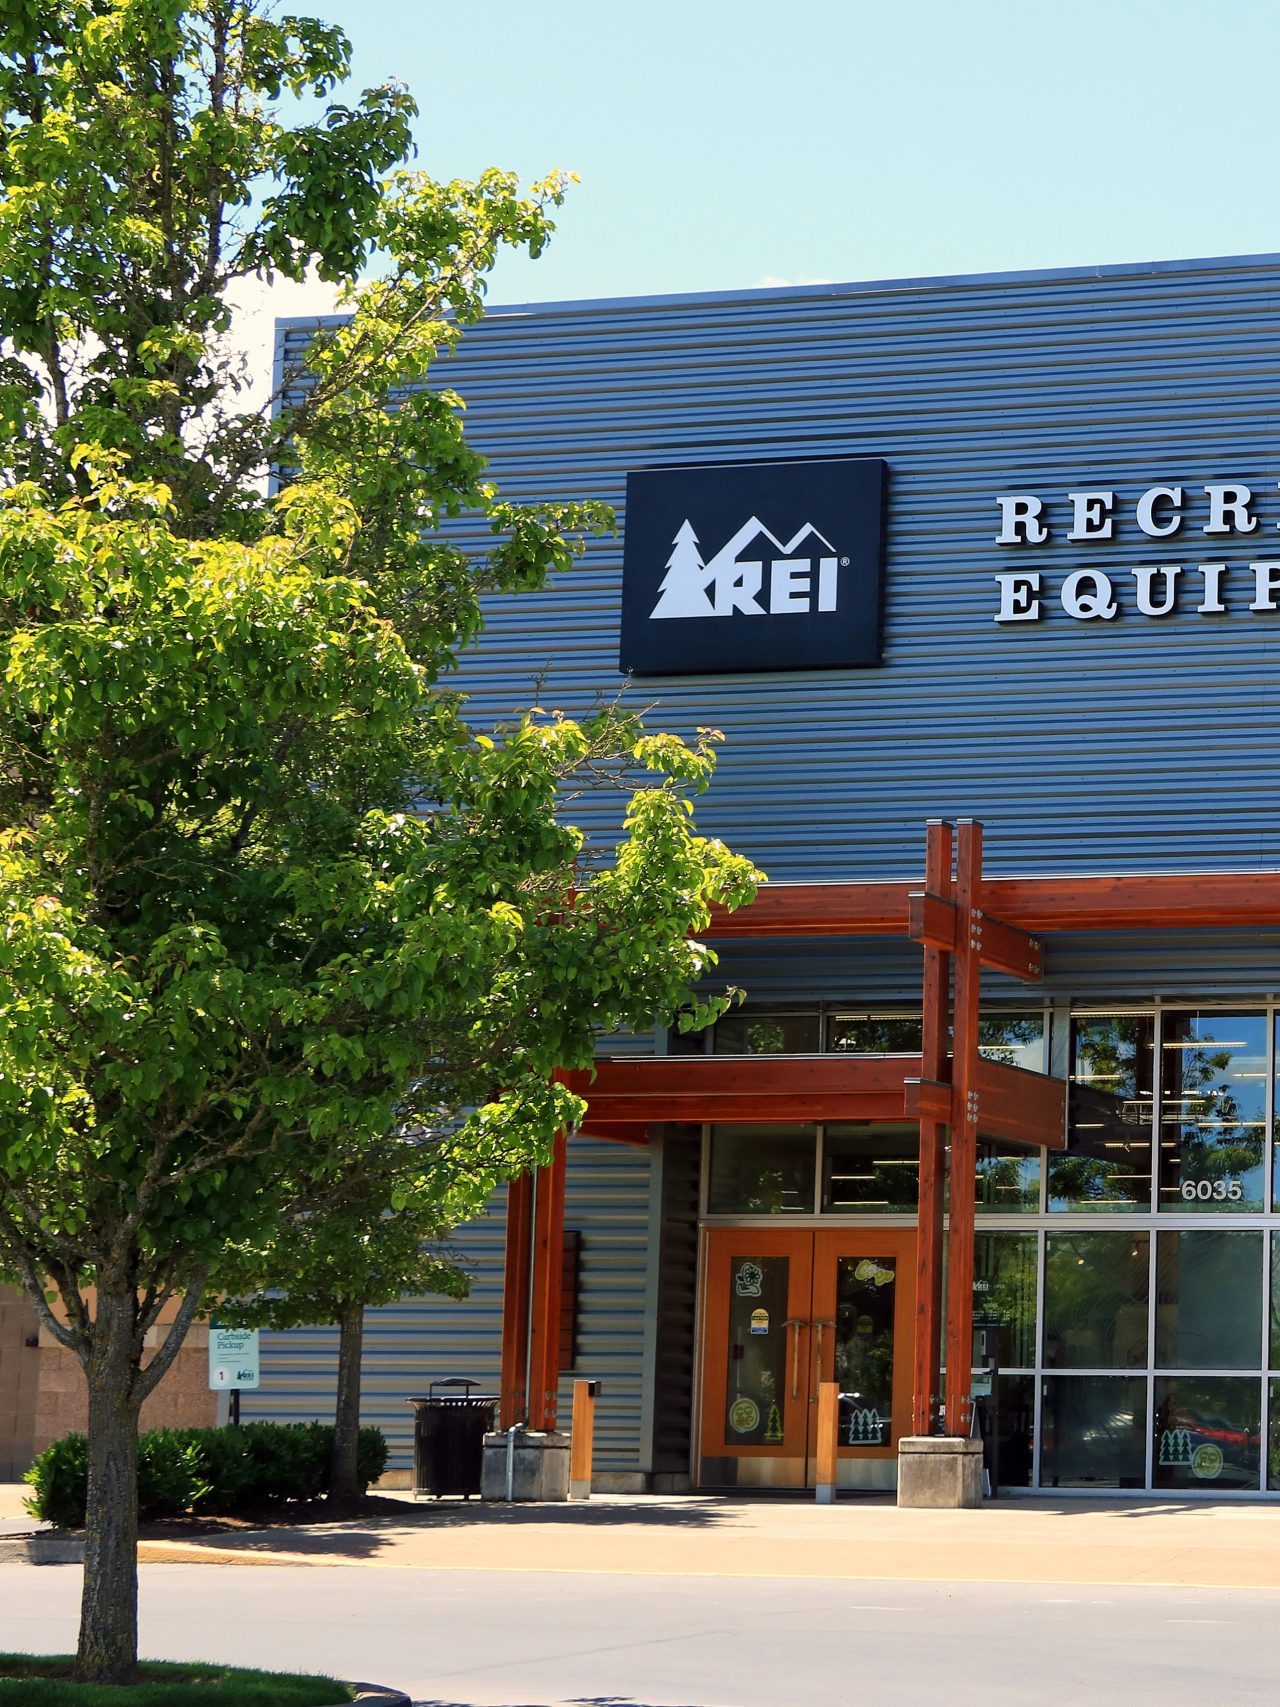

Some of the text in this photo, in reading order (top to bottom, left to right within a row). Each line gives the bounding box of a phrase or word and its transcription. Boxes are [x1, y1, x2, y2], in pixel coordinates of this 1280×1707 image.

[1181, 1180, 1242, 1201] 6035
[217, 1332, 252, 1340] Curbside
[217, 1340, 244, 1350] Pickup
[219, 1371, 224, 1381] 1
